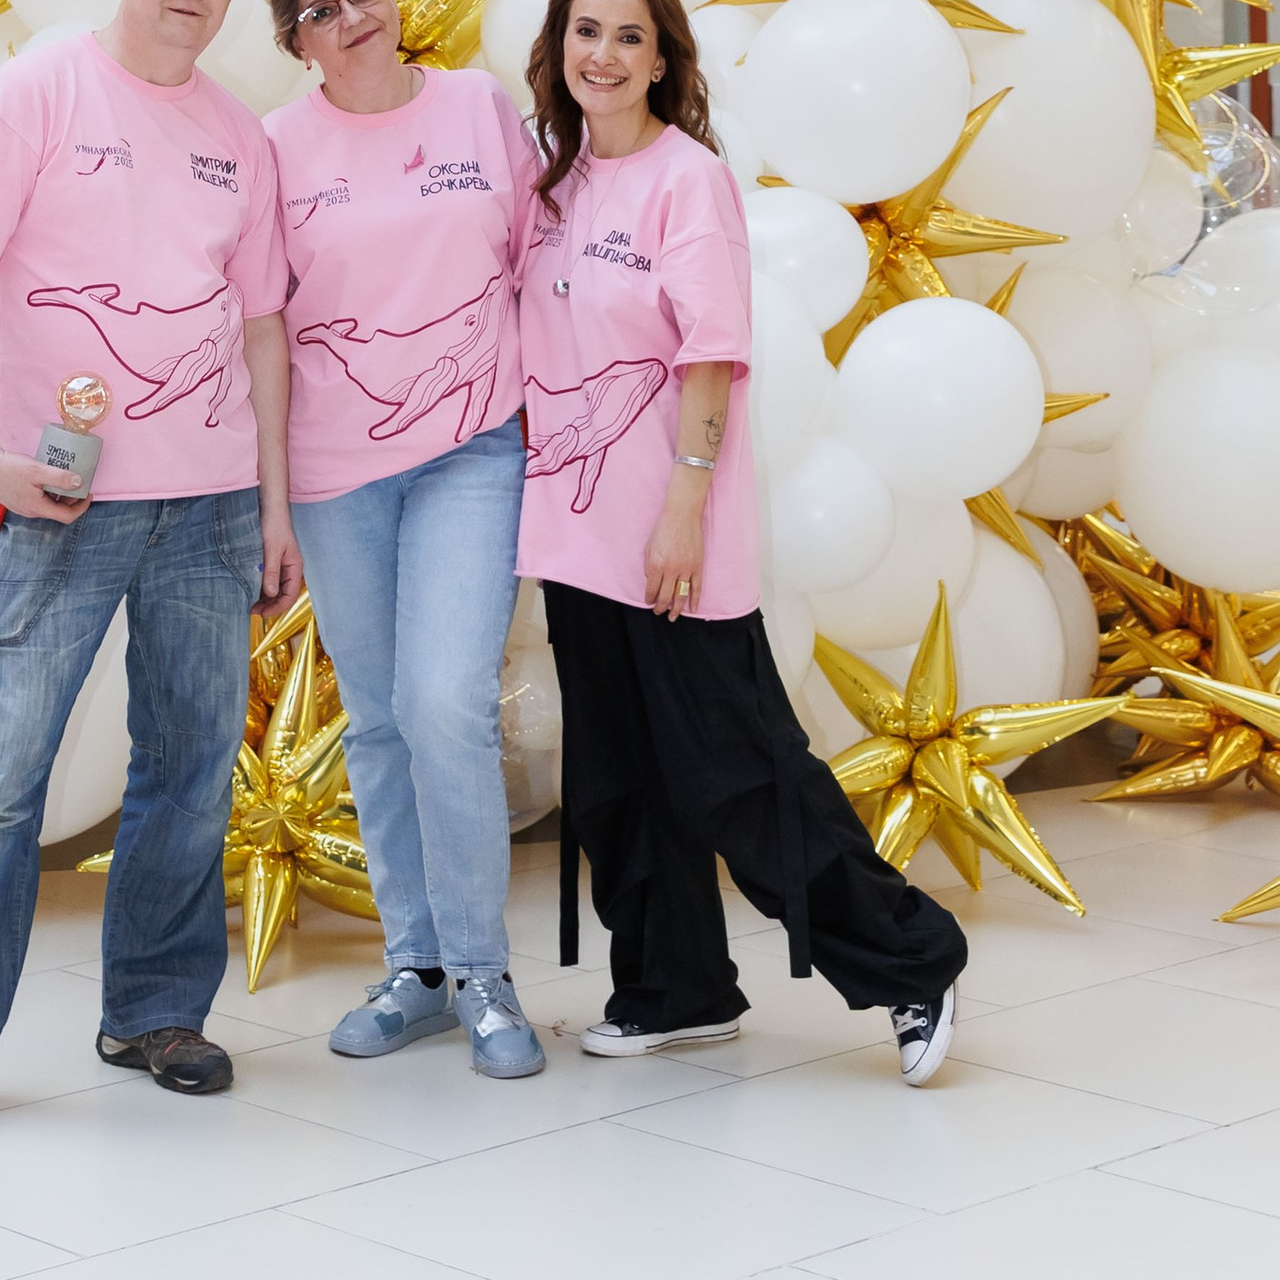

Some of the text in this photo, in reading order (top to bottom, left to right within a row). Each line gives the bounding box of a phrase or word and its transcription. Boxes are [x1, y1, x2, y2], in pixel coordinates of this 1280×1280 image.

[113, 155, 134, 170] 2025
[190, 153, 237, 176] ДМИТРИЙ
[428, 160, 481, 179] ОКСАНА
[190, 165, 239, 194] ТИЩЕНКО
[420, 176, 493, 198] БОЧКАРЕВА
[286, 186, 350, 210] УМНАЯ ВЕСНА
[325, 194, 351, 207] 2025
[603, 230, 631, 248] ДИНА
[46, 444, 76, 463] УМНАЯ
[47, 457, 71, 471] ВЕСНА
